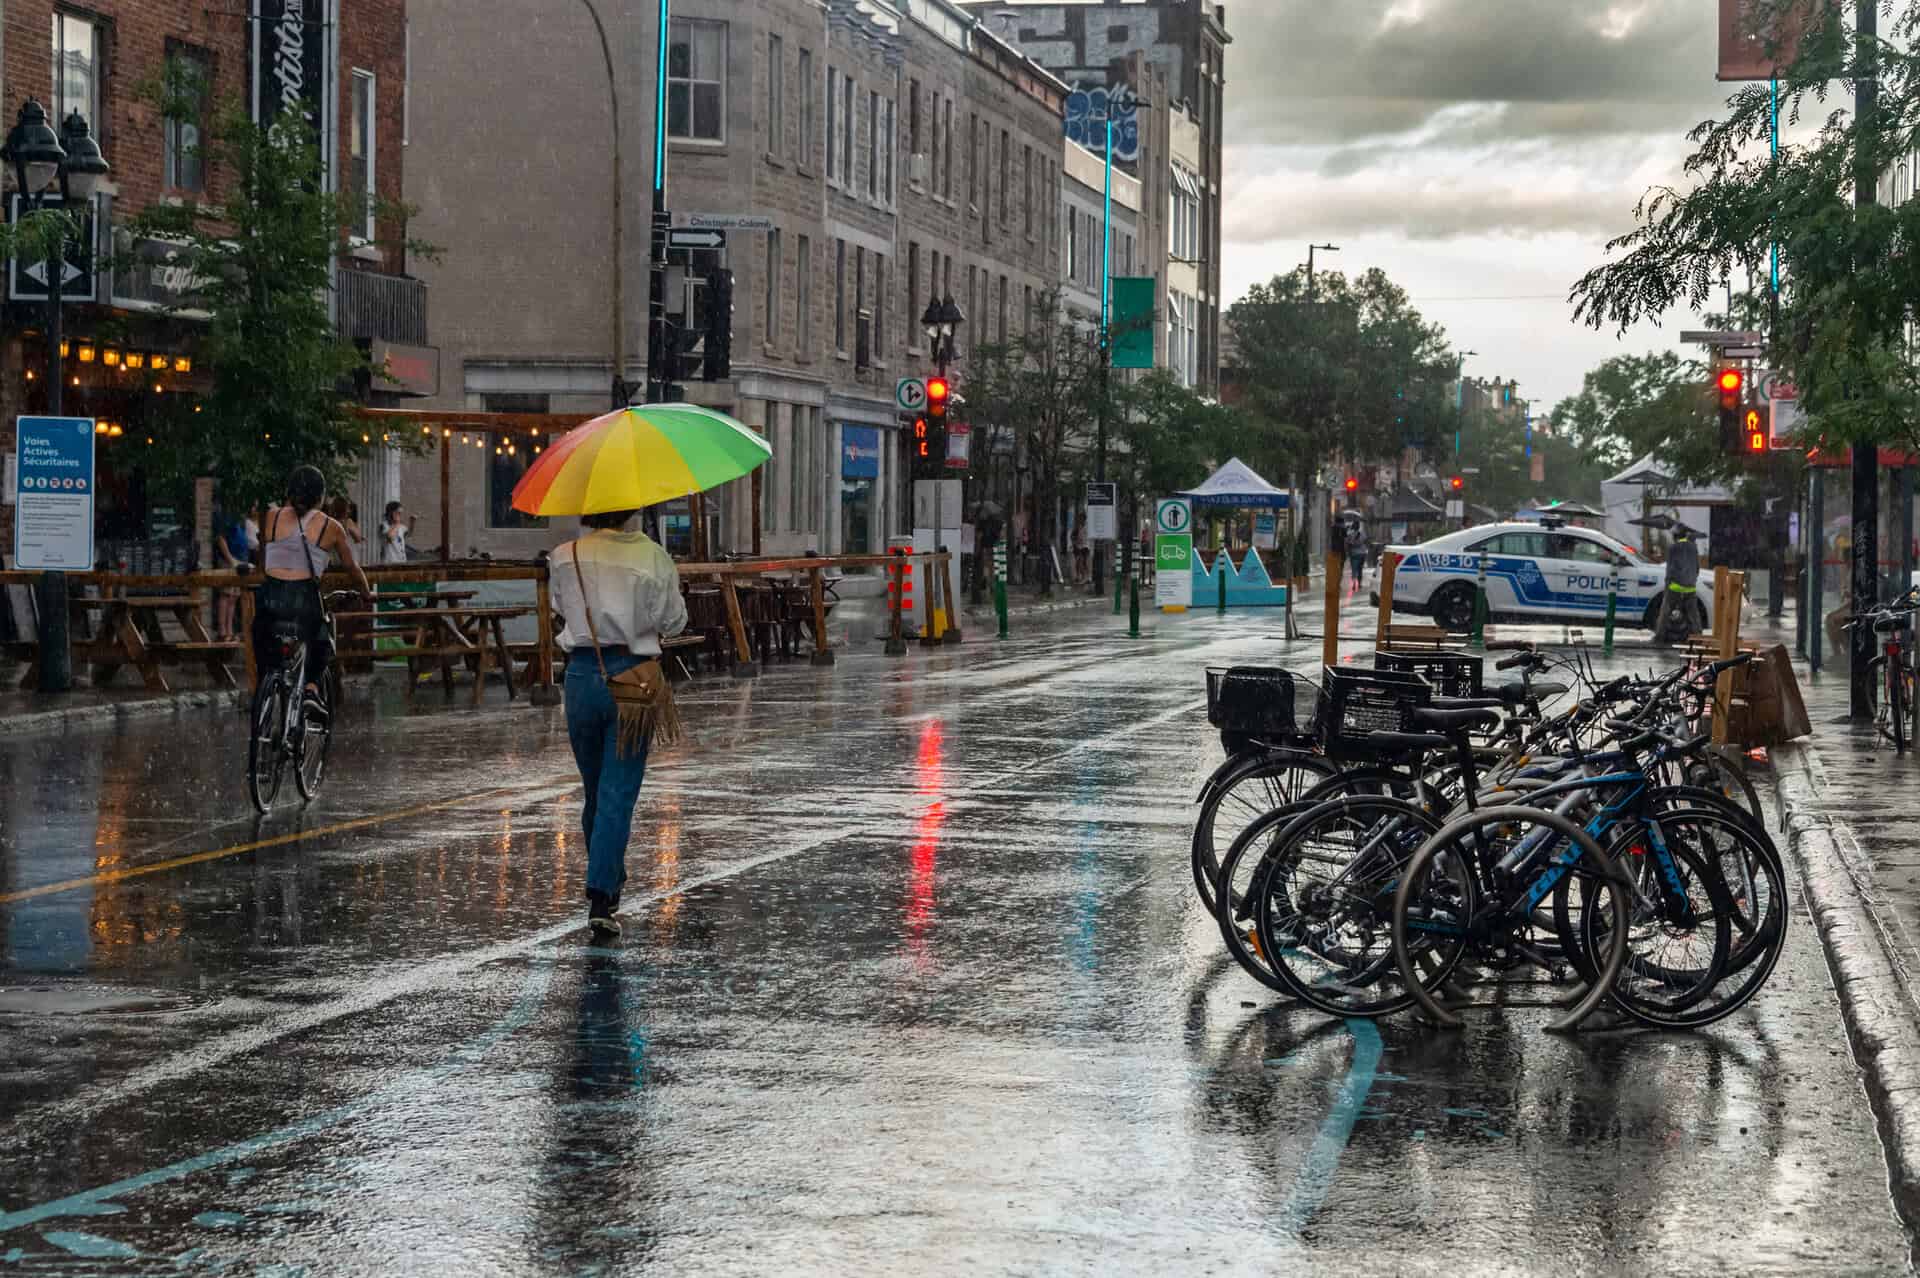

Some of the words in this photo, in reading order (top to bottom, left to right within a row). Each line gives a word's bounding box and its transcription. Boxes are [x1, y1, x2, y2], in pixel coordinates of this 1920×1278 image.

[23, 435, 50, 446] Voies
[23, 447, 60, 456] Actives
[23, 456, 80, 467] Sécuritaires
[1431, 553, 1473, 568] 38-10
